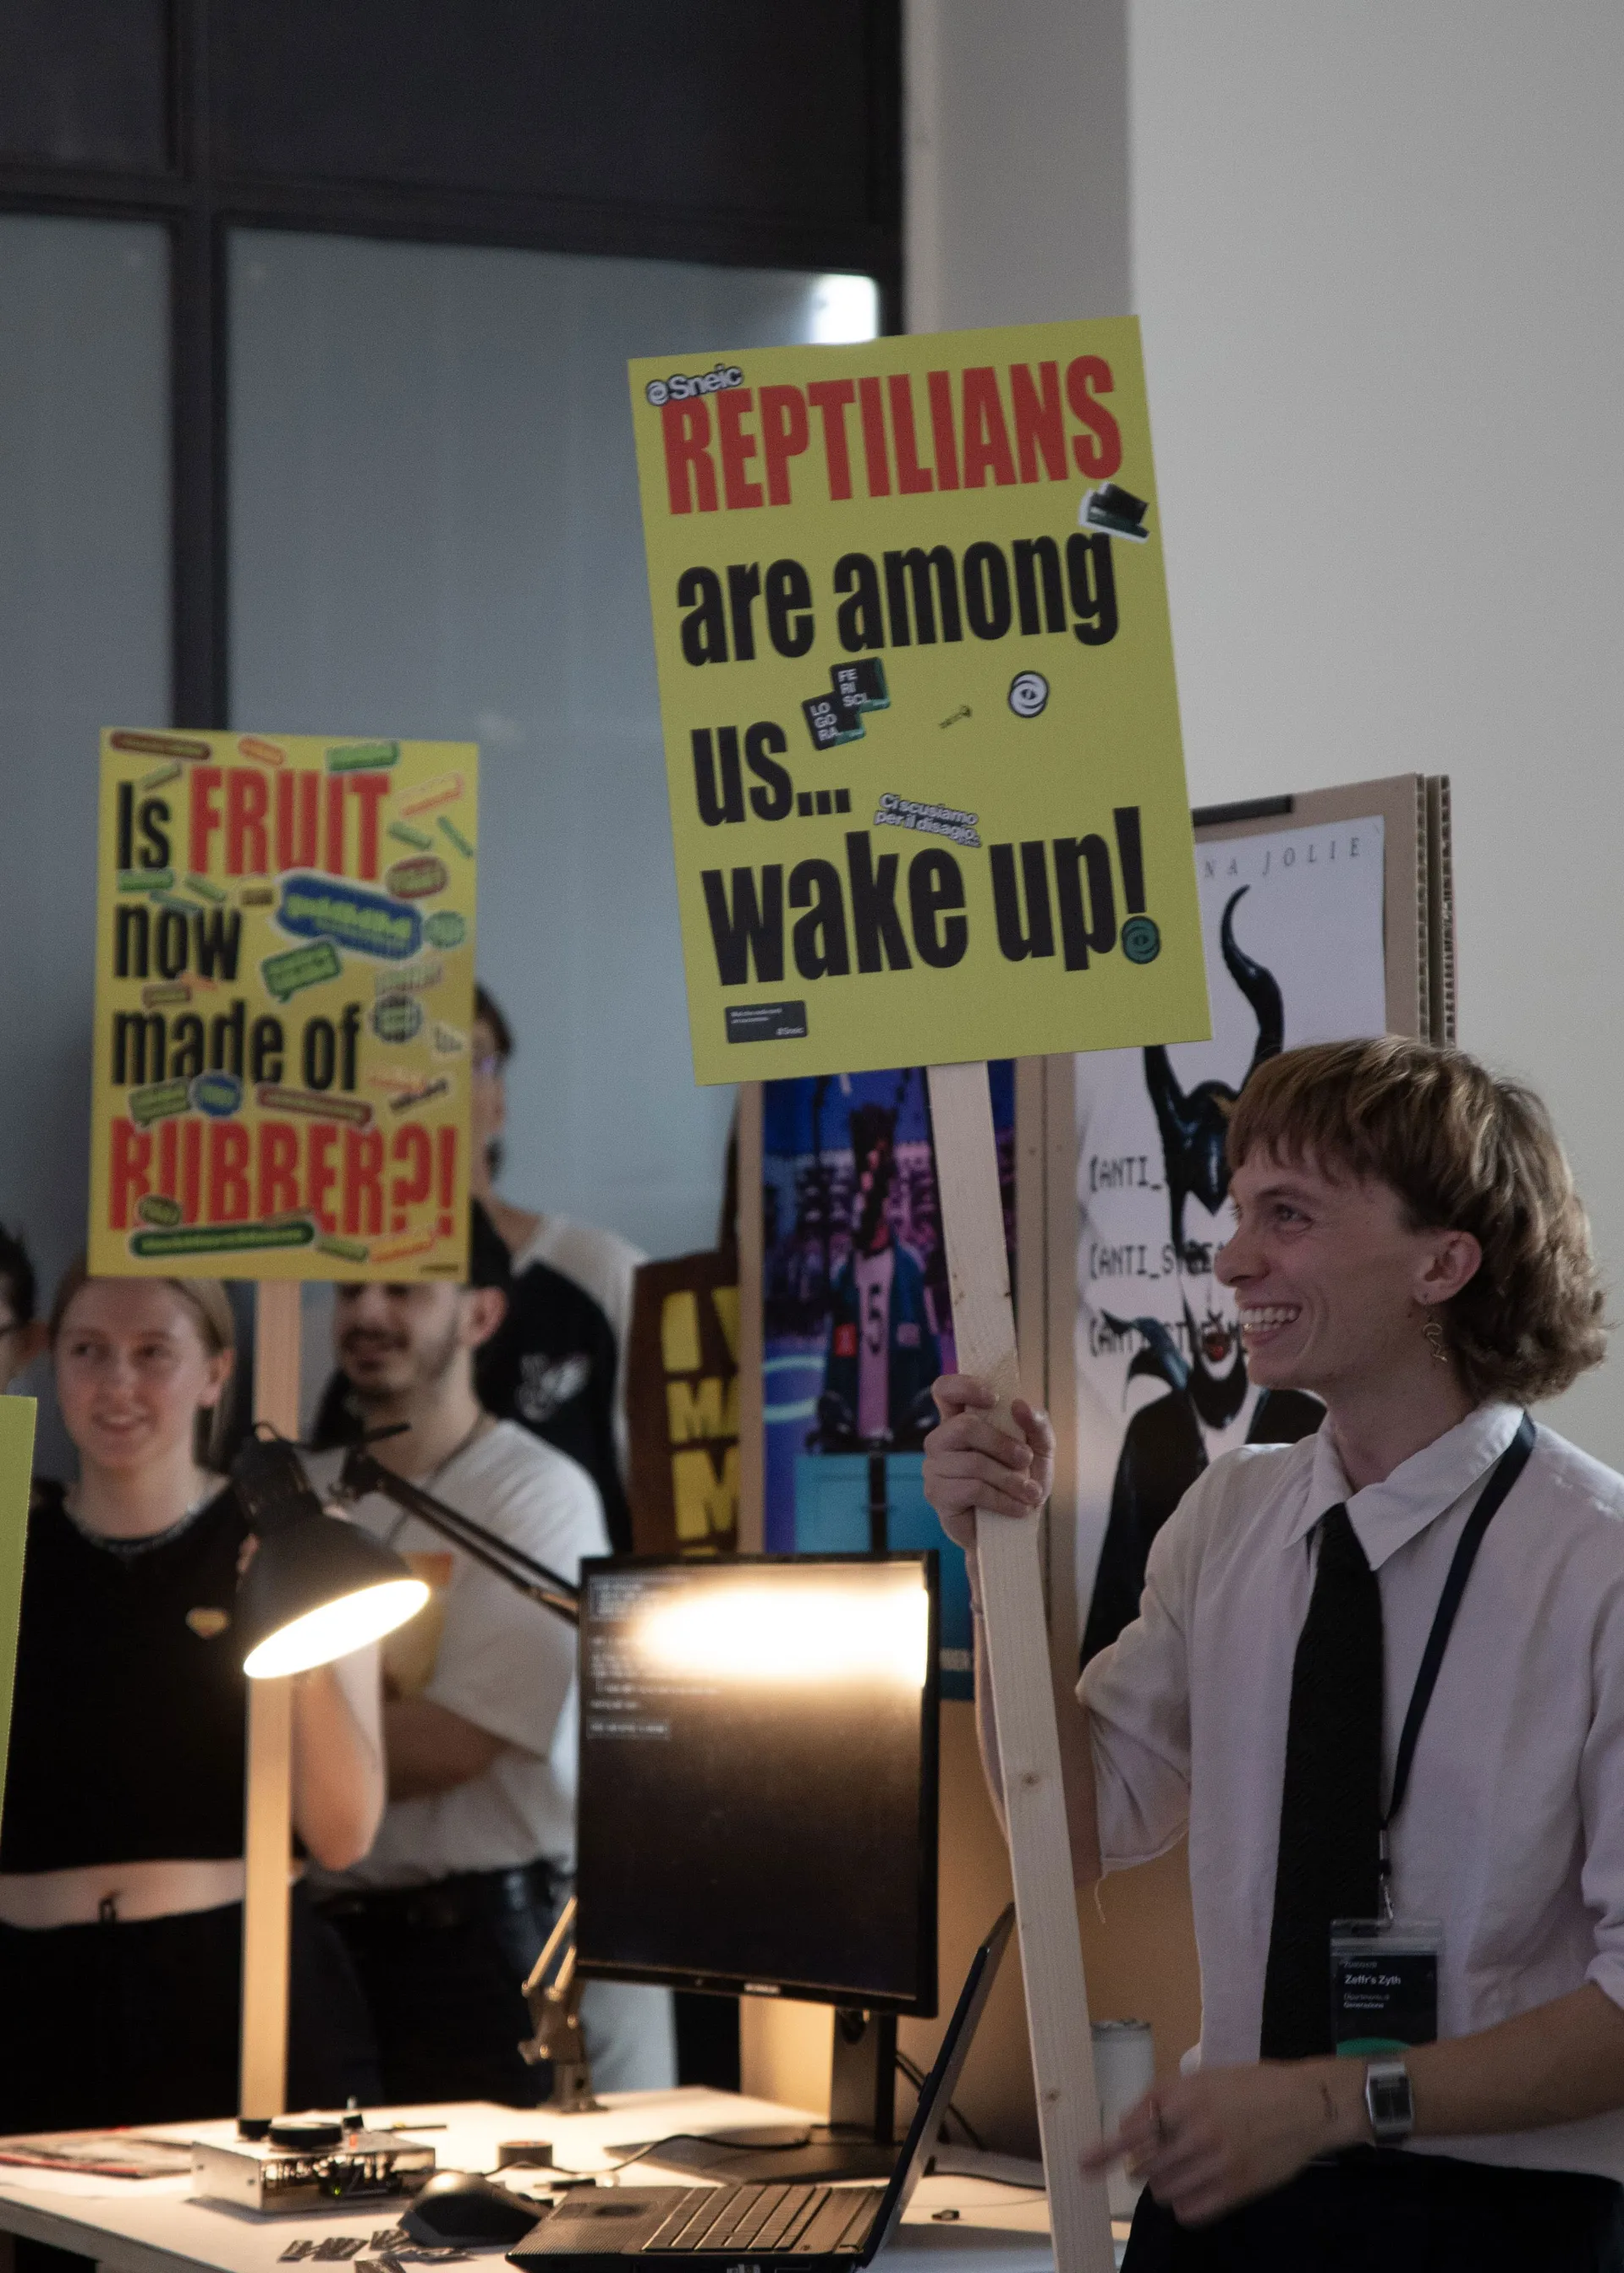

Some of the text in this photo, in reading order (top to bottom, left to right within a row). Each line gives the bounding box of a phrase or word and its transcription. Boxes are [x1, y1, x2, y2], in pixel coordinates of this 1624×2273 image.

[660, 354, 1122, 514] REPTILIANS
[676, 531, 1121, 667] are among
[117, 766, 392, 881] Is FRUIT
[690, 720, 853, 827] us...
[699, 806, 1161, 987] wake up!
[1261, 837, 1360, 876] JOLIE
[113, 903, 243, 980] now
[111, 997, 284, 1087] made
[302, 1002, 362, 1091] of
[108, 1116, 458, 1238] RUBBER?!
